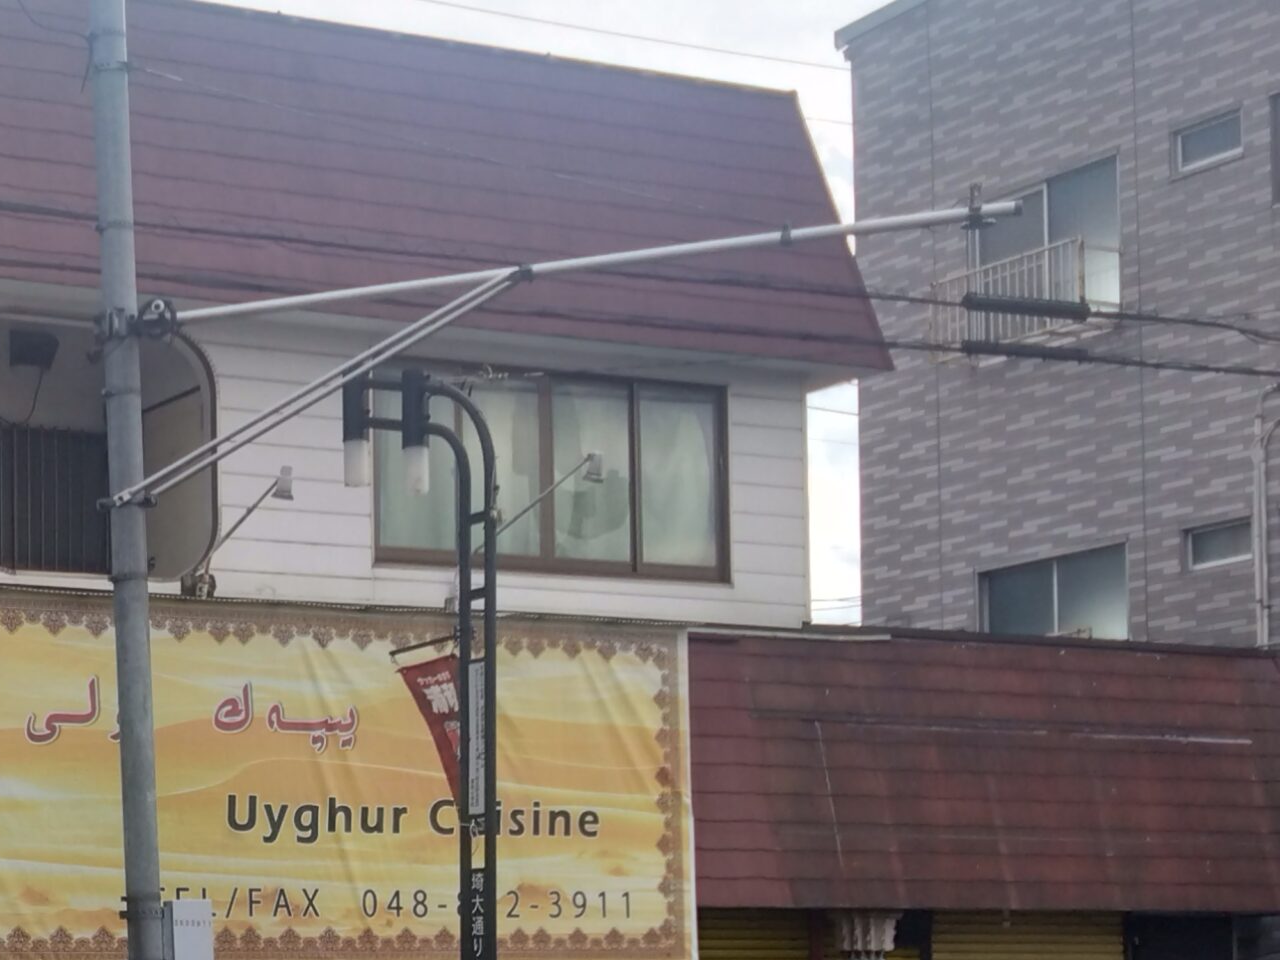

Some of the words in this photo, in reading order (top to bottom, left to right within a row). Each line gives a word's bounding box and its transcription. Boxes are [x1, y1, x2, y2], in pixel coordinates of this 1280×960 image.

[227, 794, 408, 843] Uyghur
[429, 799, 600, 838] Cisine
[362, 888, 632, 920] 048-2-3911
